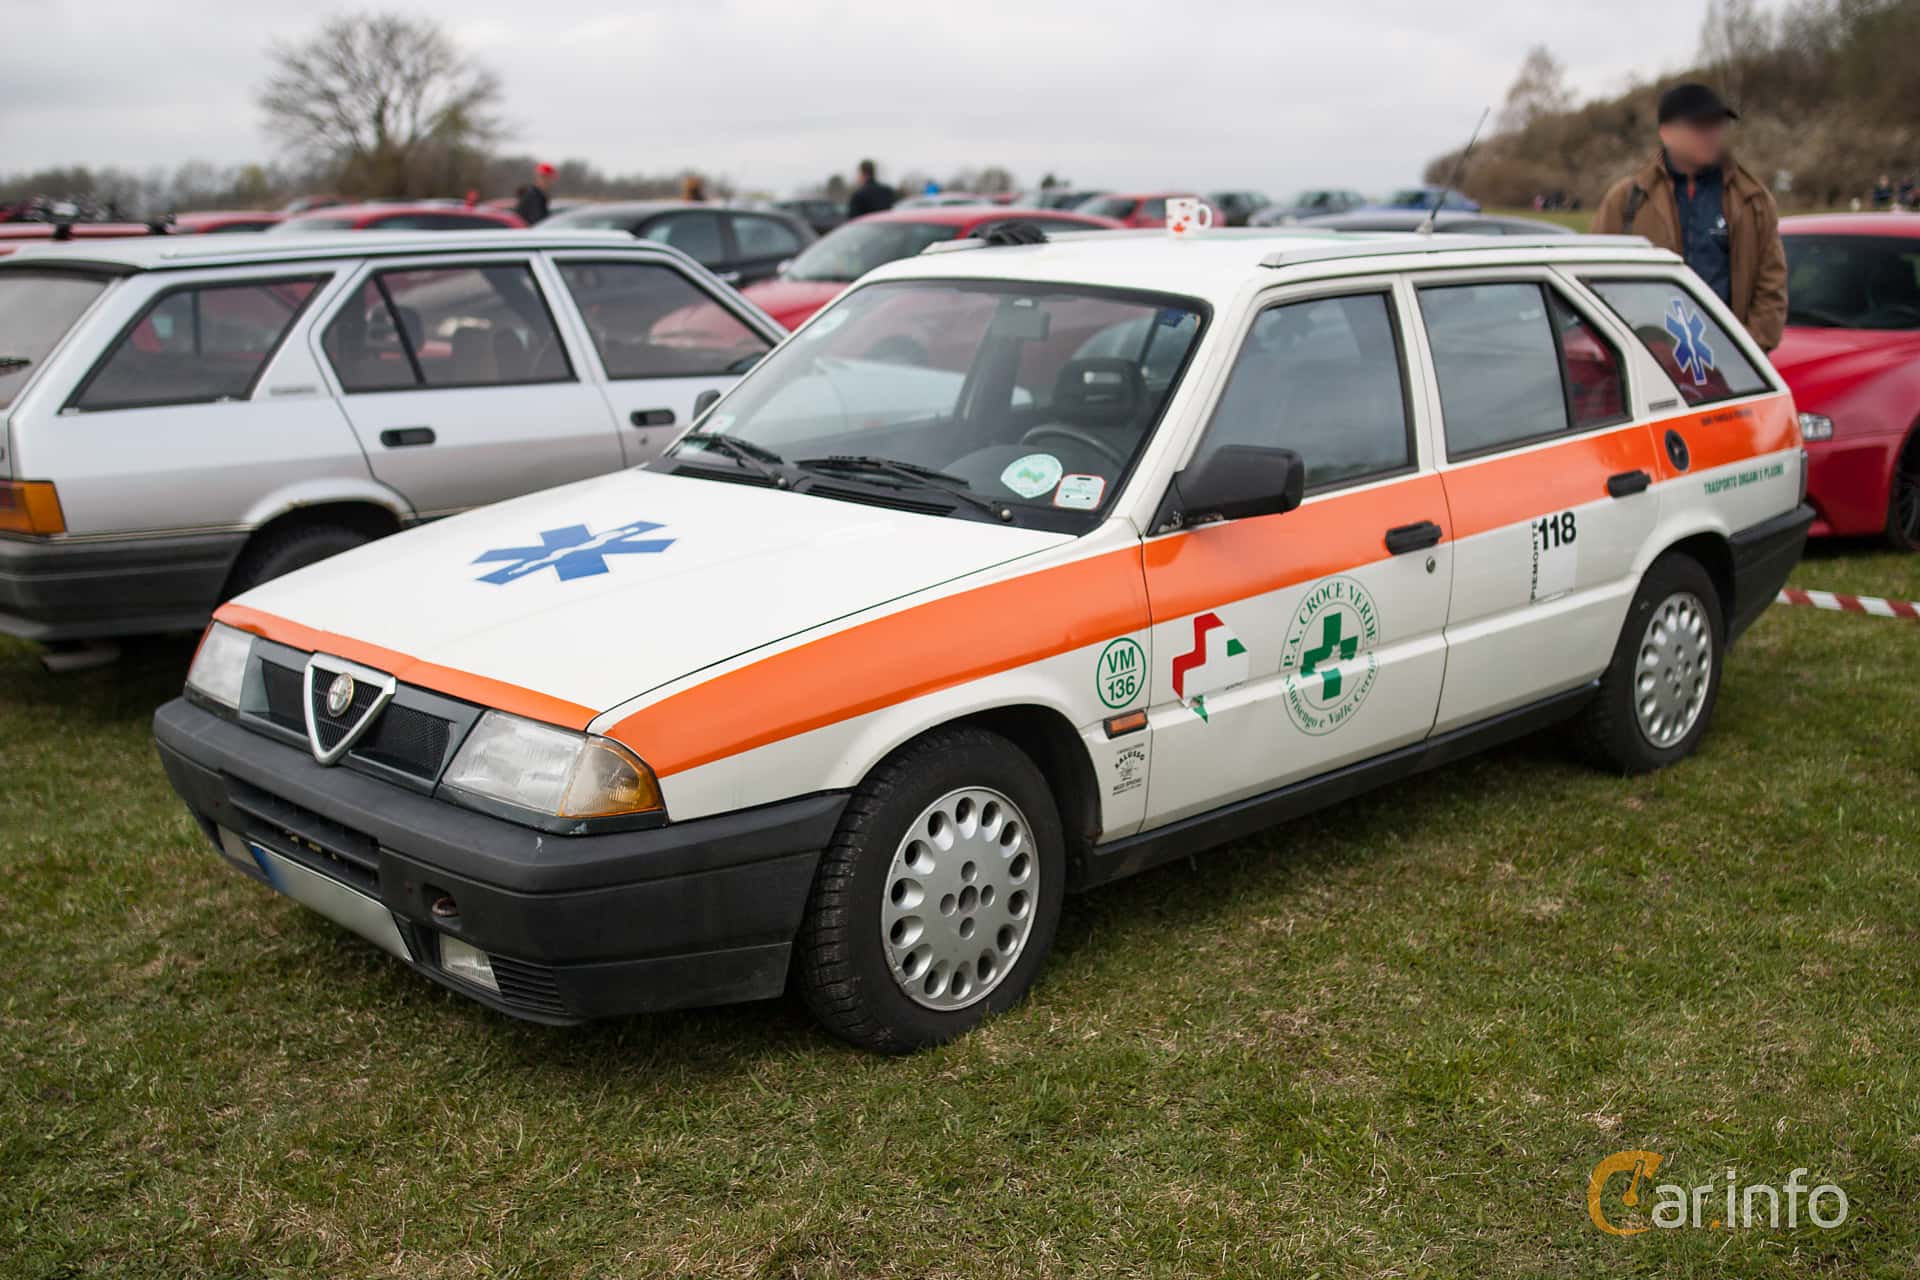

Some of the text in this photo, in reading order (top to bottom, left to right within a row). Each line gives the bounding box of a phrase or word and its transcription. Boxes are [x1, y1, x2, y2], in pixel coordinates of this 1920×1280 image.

[1538, 511, 1577, 550] 118
[1530, 521, 1539, 601] PIEMONTE
[1299, 582, 1345, 625] CROCE
[1348, 584, 1376, 640] VERDE
[1107, 646, 1135, 674] VM
[1107, 675, 1136, 701] 136
[1328, 702, 1353, 725] Valle
